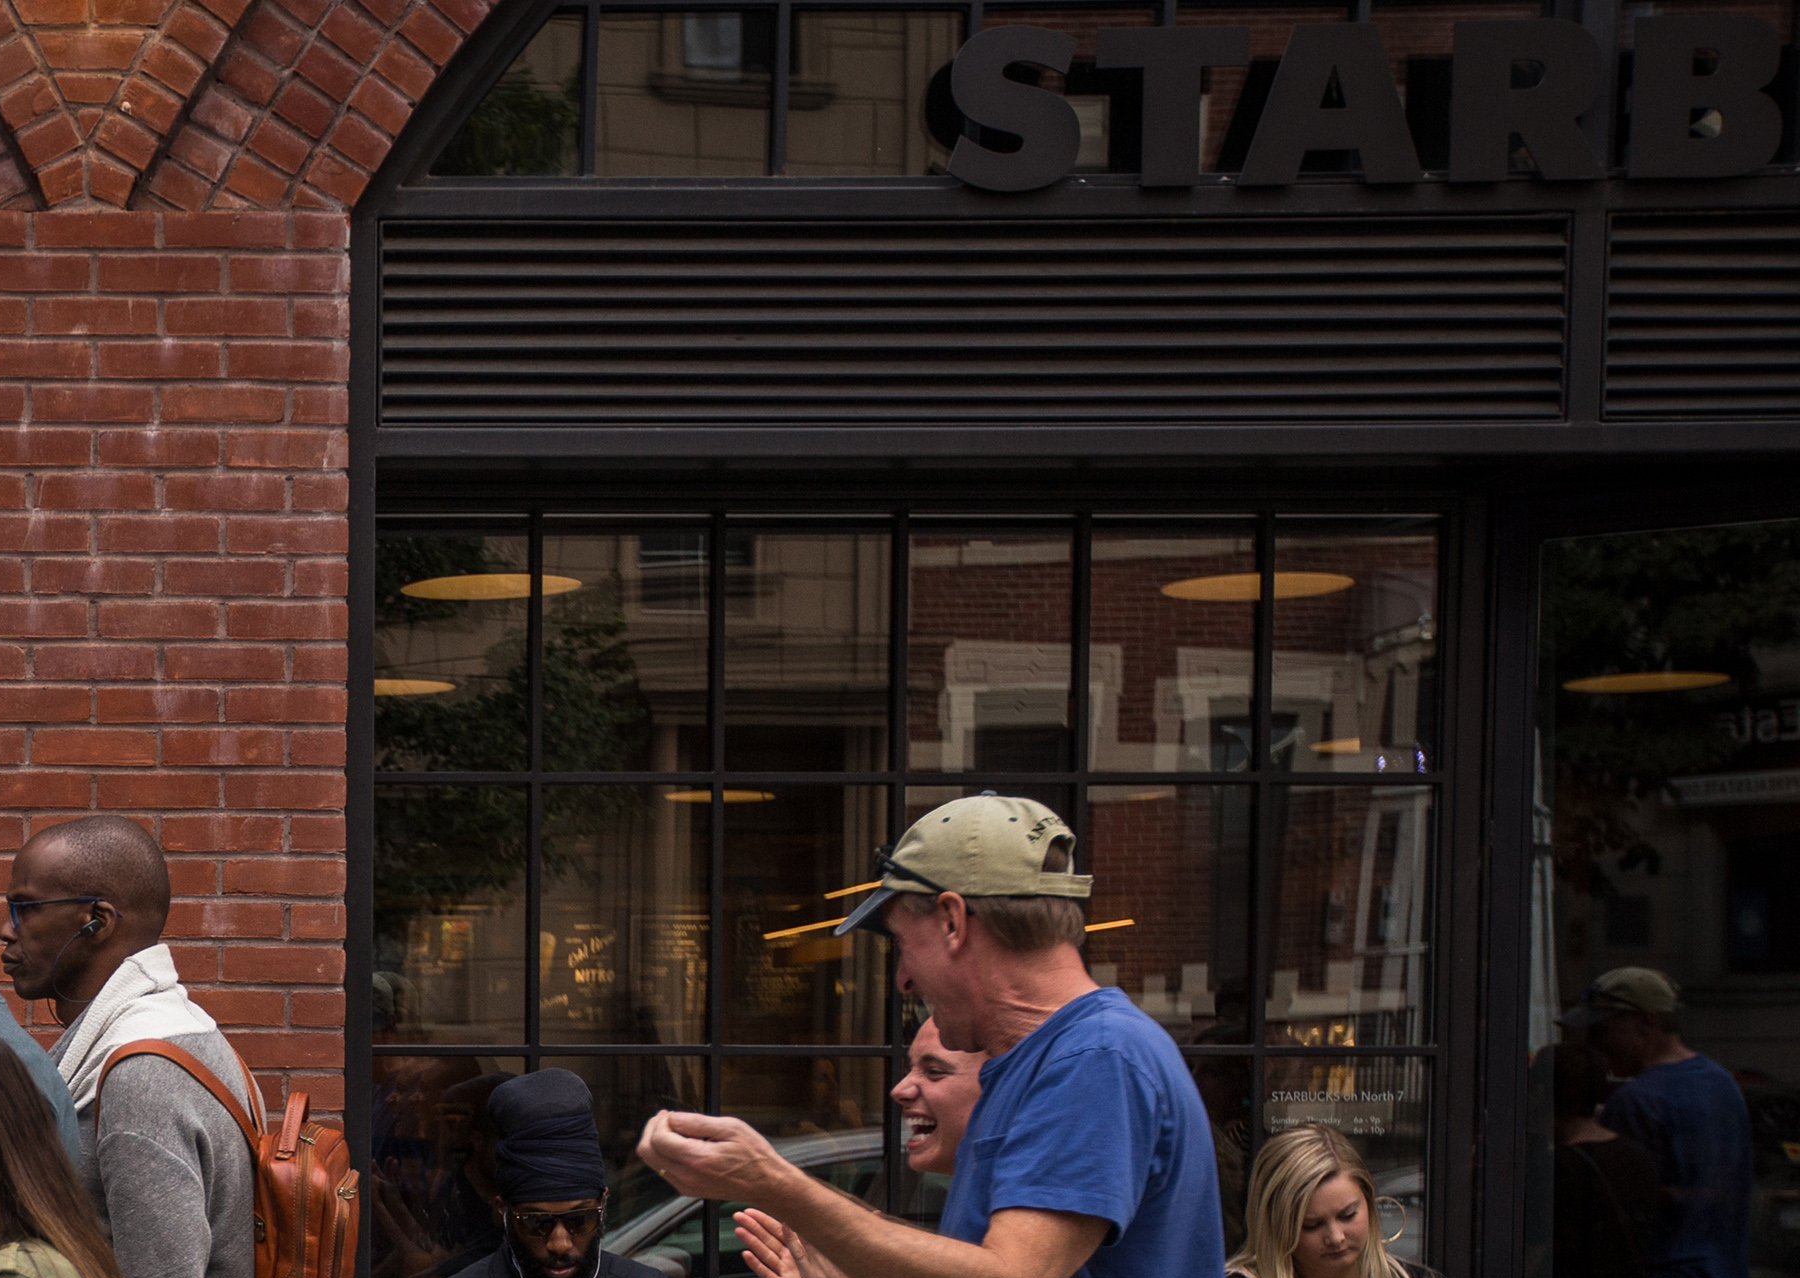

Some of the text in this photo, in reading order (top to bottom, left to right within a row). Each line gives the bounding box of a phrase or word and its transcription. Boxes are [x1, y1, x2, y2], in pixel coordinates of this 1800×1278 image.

[948, 15, 1784, 192] STARB
[574, 967, 616, 983] NITRO
[1271, 1090, 1404, 1102] STARBUCKS on North 7
[1270, 1116, 1299, 1125] Sunday
[1369, 1116, 1381, 1125] 9p
[1370, 1126, 1386, 1136] 10p
